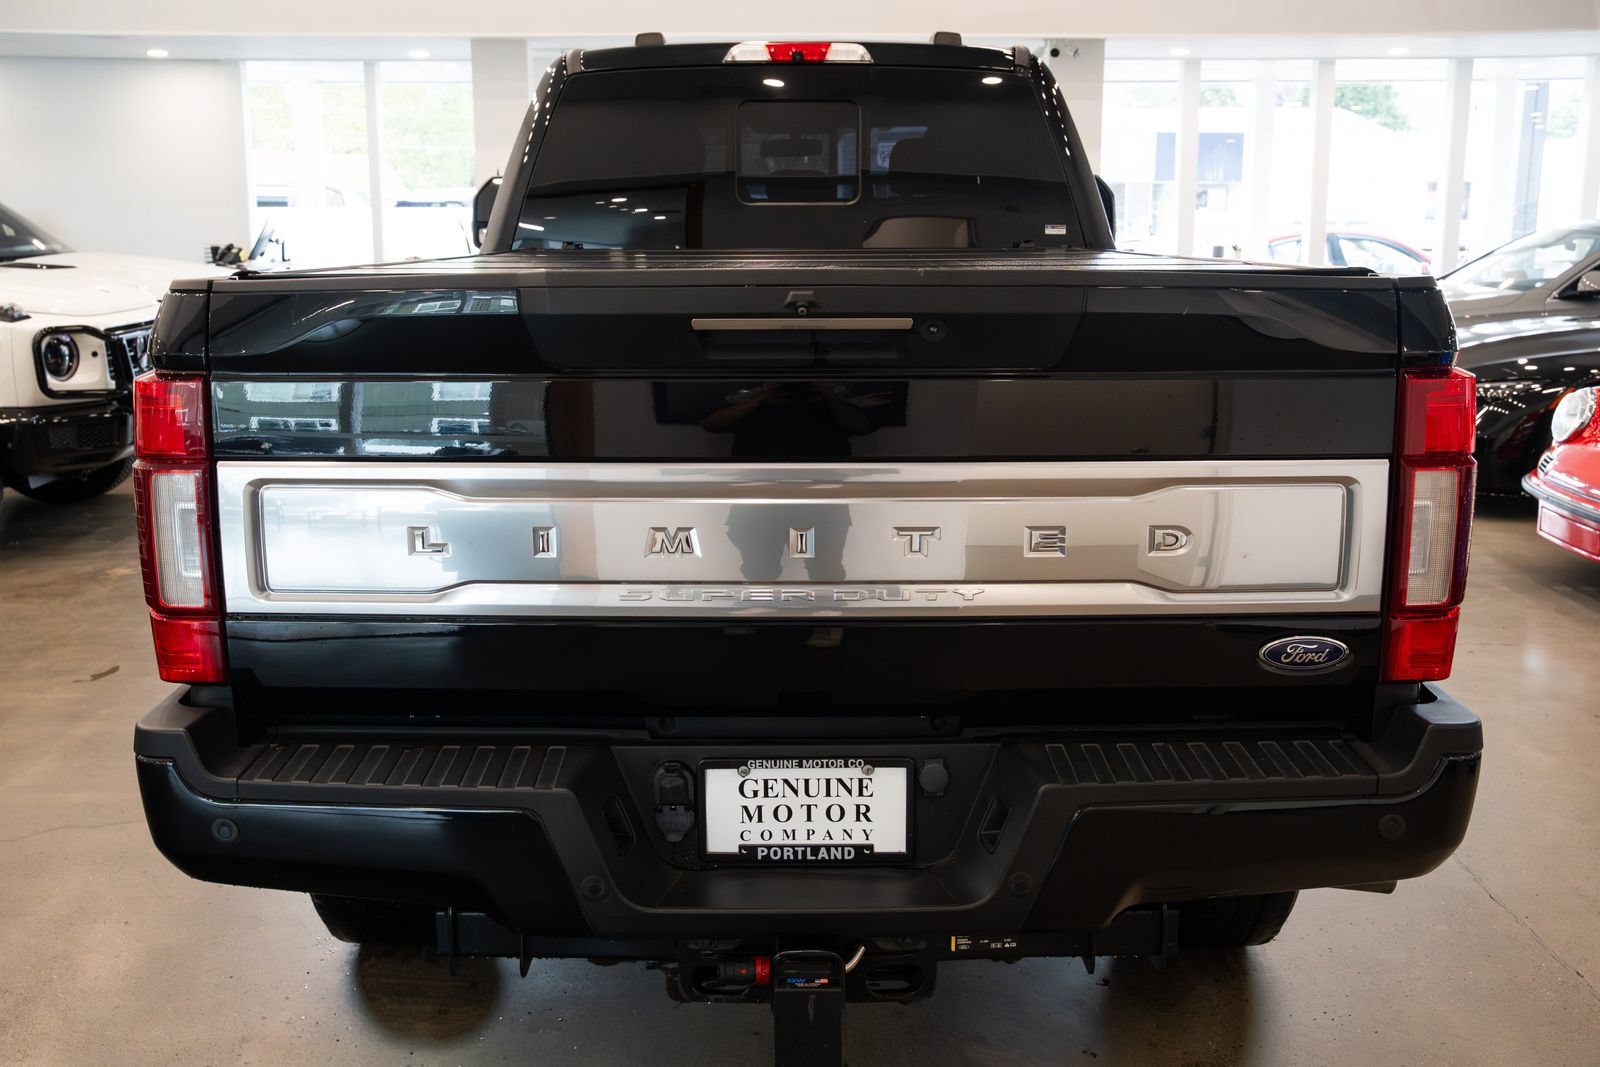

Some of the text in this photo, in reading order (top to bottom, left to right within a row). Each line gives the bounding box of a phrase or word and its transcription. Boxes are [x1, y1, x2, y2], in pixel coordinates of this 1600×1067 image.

[406, 524, 1193, 558] LIMITED
[618, 588, 985, 602] SUPER DUTY
[1280, 643, 1330, 663] Ford
[747, 759, 799, 769] GENUINE
[802, 759, 845, 769] MOTOR
[738, 777, 874, 799] GENUINE
[739, 803, 873, 824] MOTOR
[739, 828, 873, 842] COMPANY
[757, 846, 856, 861] PORTLAND
